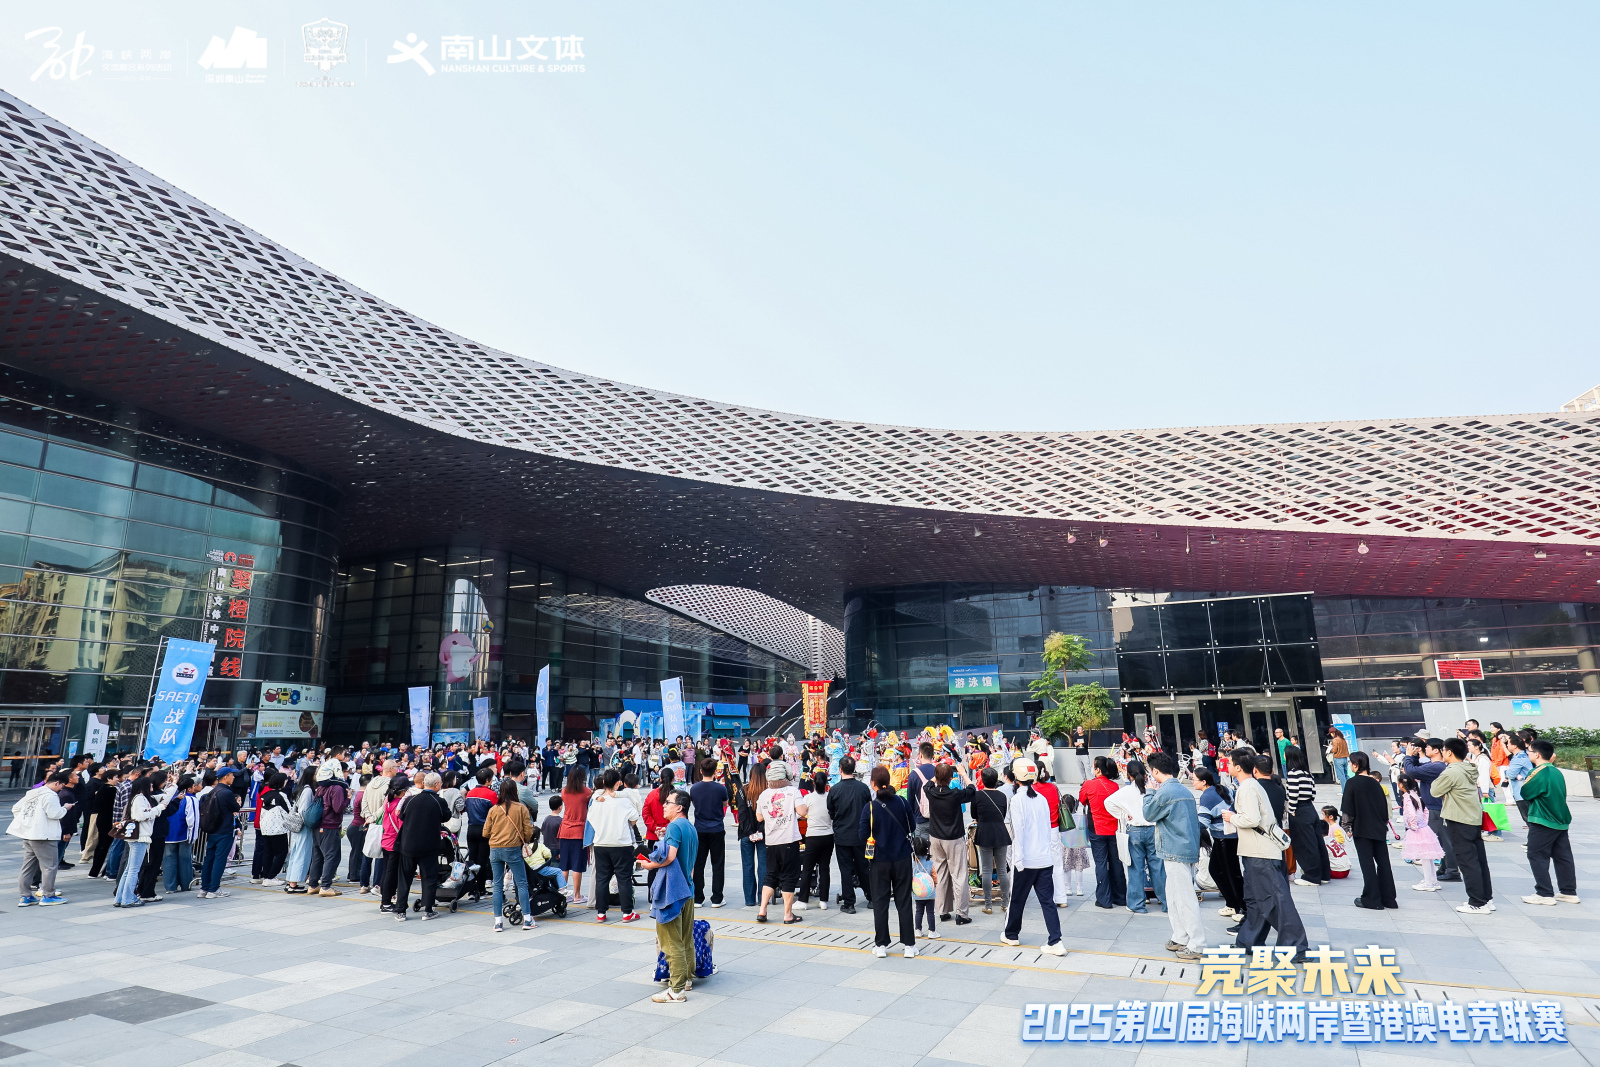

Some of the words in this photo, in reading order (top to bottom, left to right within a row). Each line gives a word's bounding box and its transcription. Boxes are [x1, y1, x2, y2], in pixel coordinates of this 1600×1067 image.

[220, 569, 252, 677] 聚橙院线
[954, 676, 993, 689] 游泳馆
[157, 690, 200, 704] SAETA
[159, 707, 186, 745] 战队
